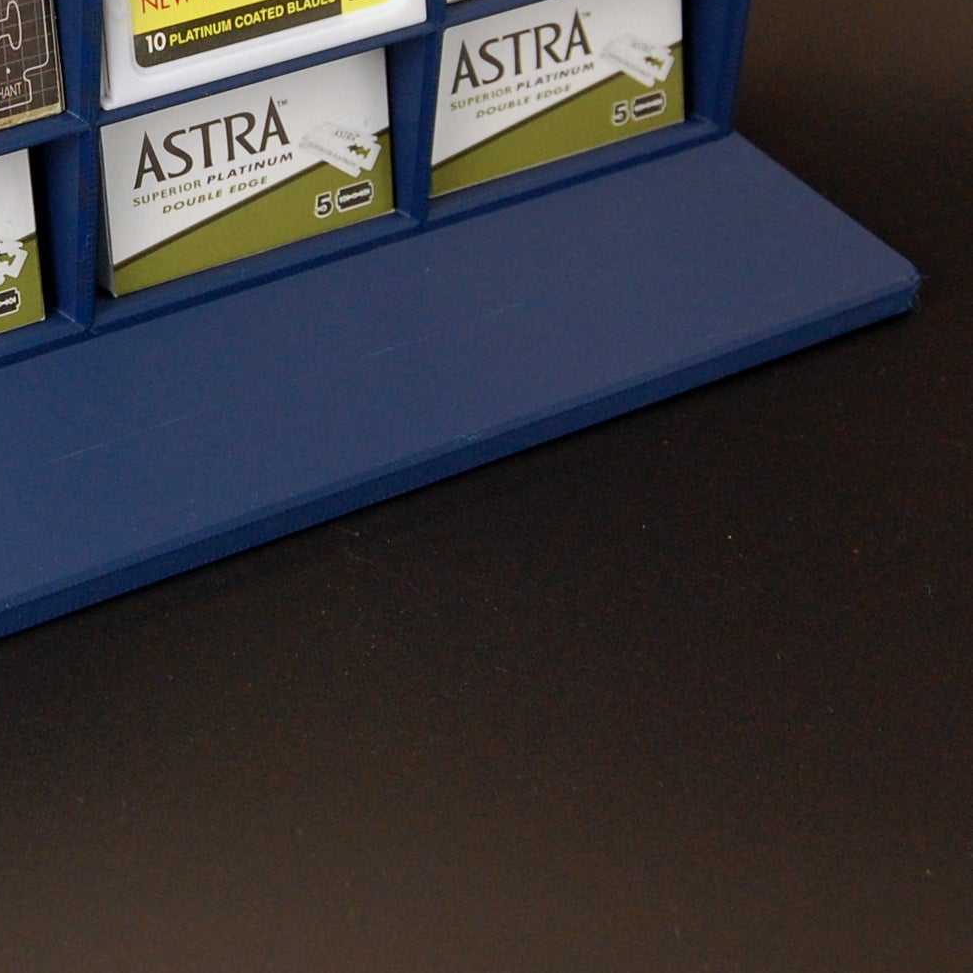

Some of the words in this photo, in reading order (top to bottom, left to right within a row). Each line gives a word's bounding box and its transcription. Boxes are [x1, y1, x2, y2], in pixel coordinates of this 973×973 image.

[145, 33, 165, 54] 10
[169, 18, 232, 47] PLATINUM
[234, 5, 285, 28] COATED
[451, 7, 592, 95] ASTRA
[450, 86, 512, 111] SUPERIOR
[516, 63, 594, 92] PLATINUM
[476, 97, 530, 119] DOUBLE
[536, 84, 572, 101] EDGE
[612, 102, 628, 124] 5
[133, 96, 291, 190] ASTRA
[133, 179, 202, 207] SUPERIOR
[207, 152, 294, 185] PLATINUM
[162, 189, 224, 214] DOUBLE
[229, 176, 268, 194] EDGE
[315, 192, 334, 218] 5
